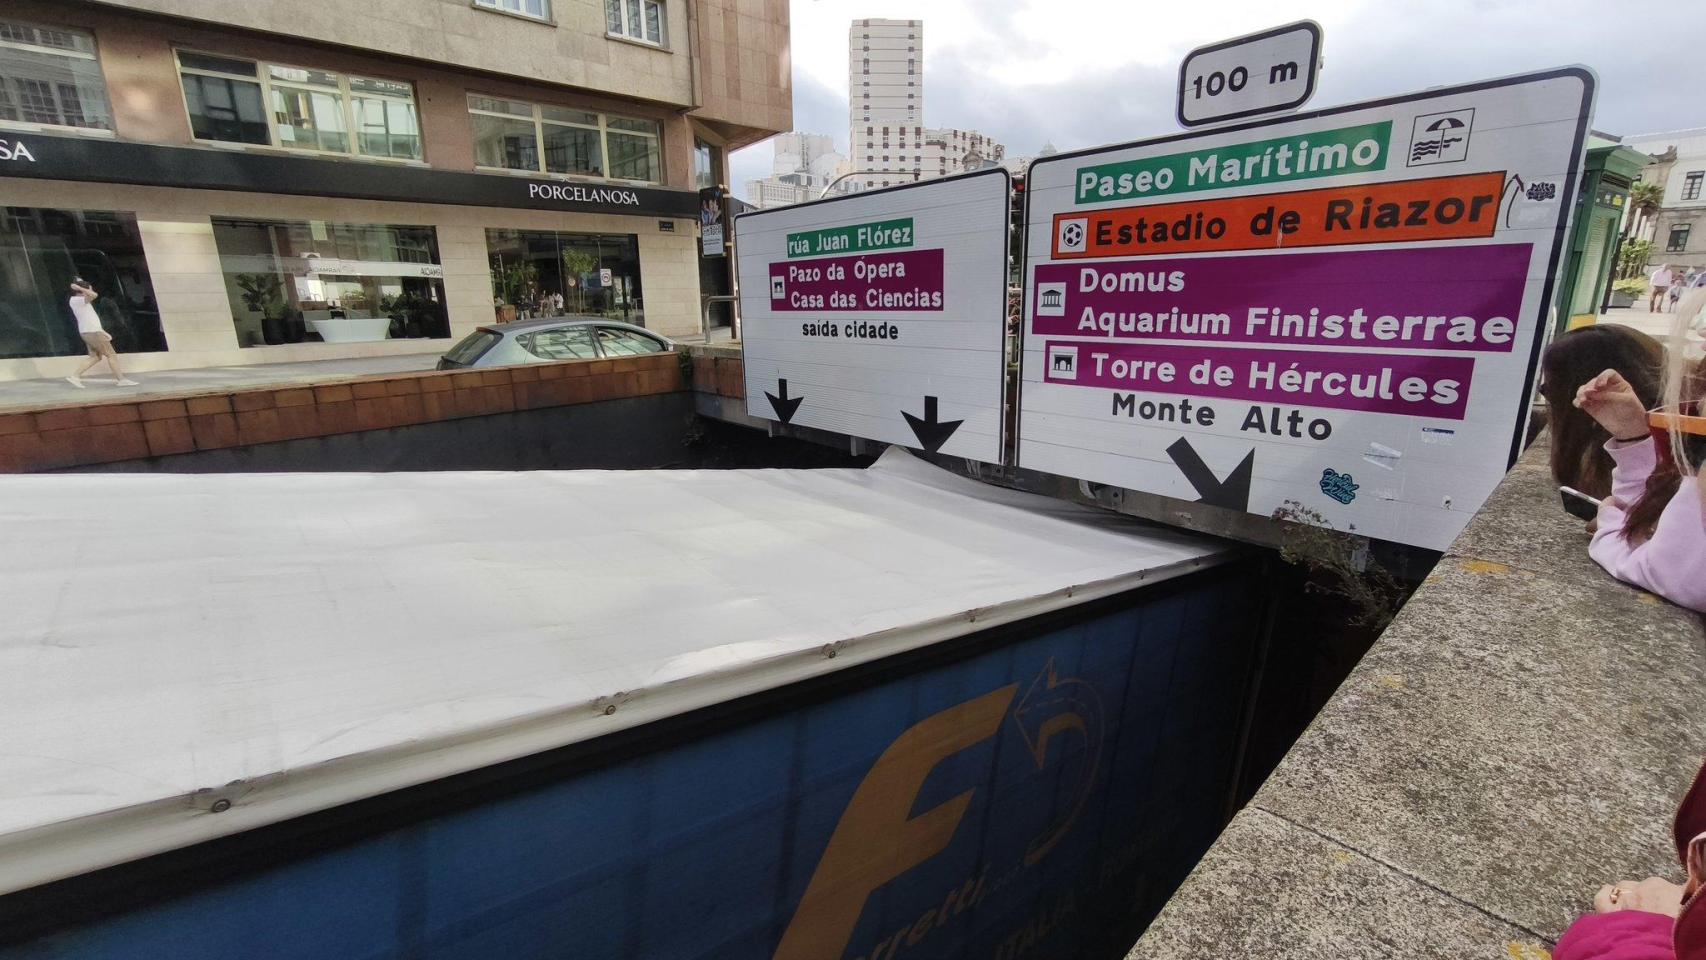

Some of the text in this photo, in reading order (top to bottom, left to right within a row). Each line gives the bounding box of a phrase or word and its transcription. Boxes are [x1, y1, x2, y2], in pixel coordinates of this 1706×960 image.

[1193, 61, 1298, 99] 100 m
[1080, 138, 1380, 198] Paseo Marítimo
[529, 183, 639, 206] PORCELANOSA
[1096, 194, 1493, 246] Estadio de Riazor
[788, 226, 911, 254] rúa Juan Flórez
[789, 256, 906, 283] Pazo da Ópera
[1079, 268, 1185, 292] Domus
[791, 288, 942, 308] Casa das Ciencias
[802, 320, 899, 339] saída cidade
[1078, 306, 1514, 344] Aquarium Finisterrae
[1091, 353, 1461, 405] Torre de Hércules
[1112, 393, 1332, 440] Monte Alto
